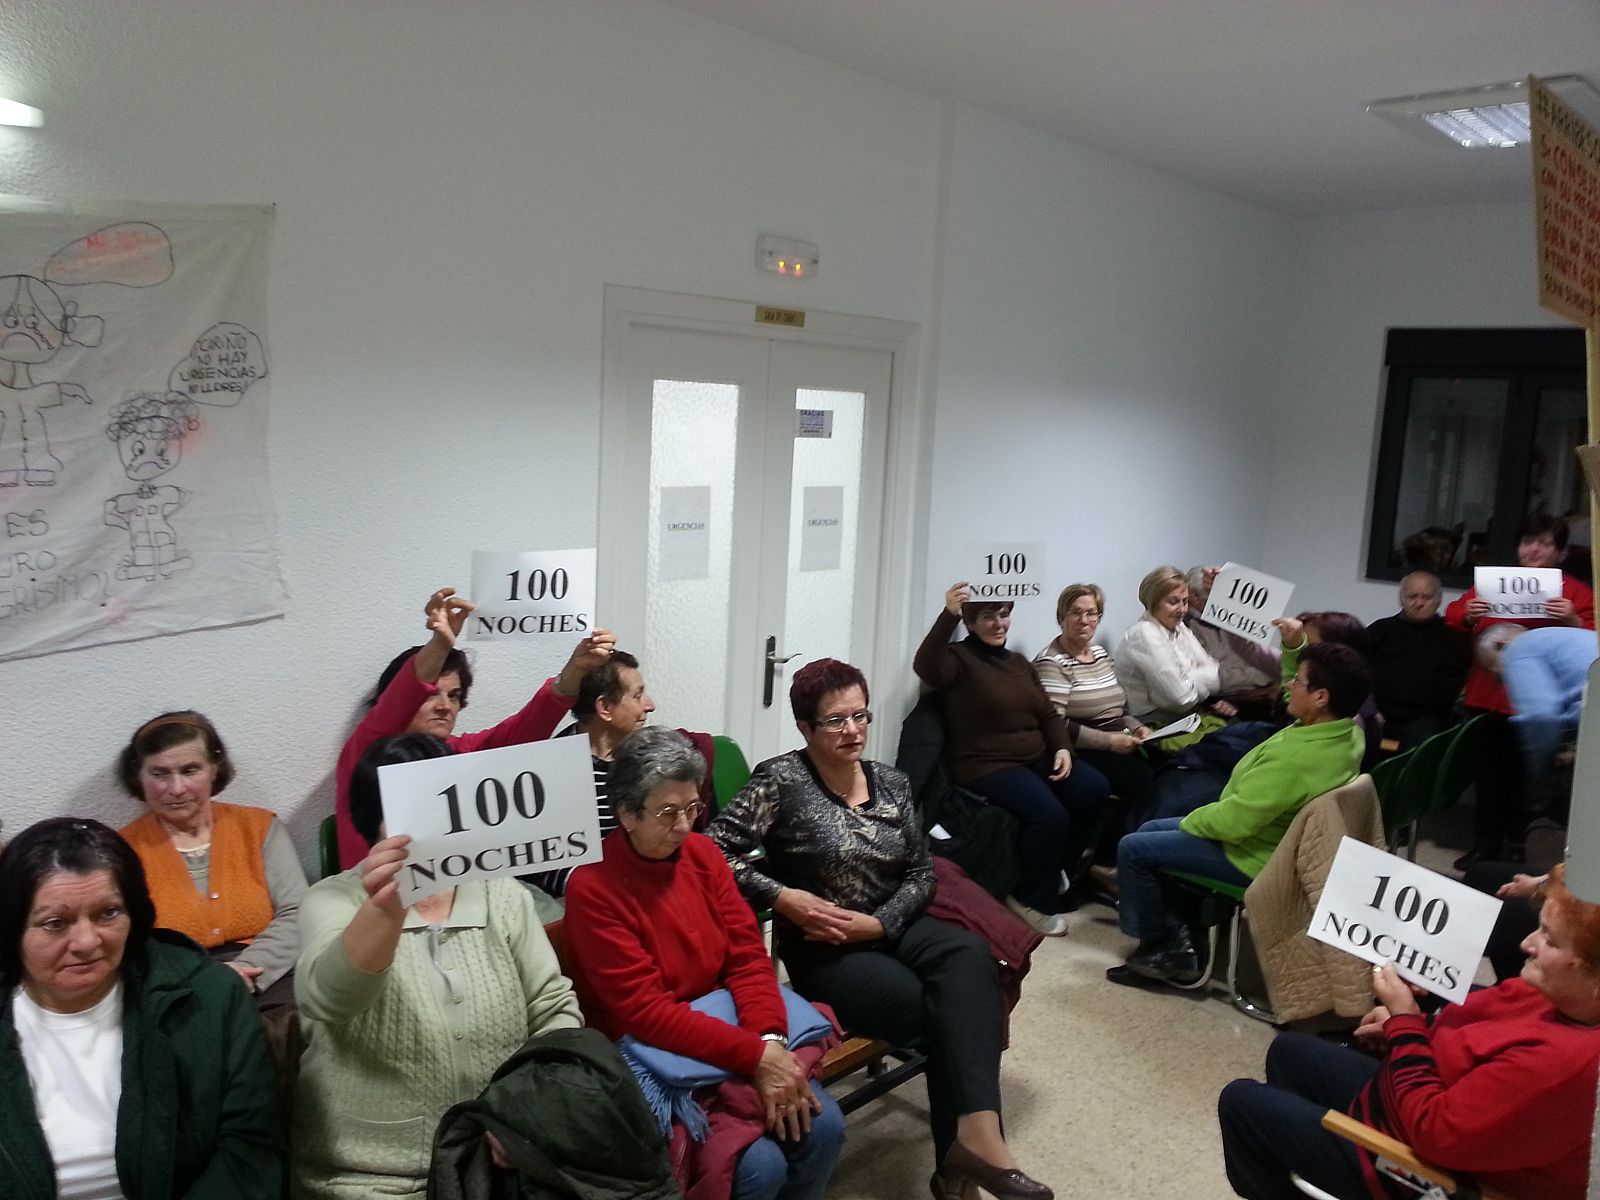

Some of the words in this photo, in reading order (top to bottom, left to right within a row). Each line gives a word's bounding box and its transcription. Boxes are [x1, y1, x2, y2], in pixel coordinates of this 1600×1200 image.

[218, 351, 248, 366] HAY
[984, 552, 1026, 575] 100
[505, 568, 569, 601] 100
[970, 583, 1041, 597] NOCHES
[1228, 578, 1269, 610] 100
[1498, 576, 1539, 595] 100
[475, 613, 588, 635] NOCHES
[1206, 603, 1271, 639] NOCHES
[1486, 602, 1547, 615] OCHE
[437, 771, 546, 836] 100
[406, 831, 589, 892] NOCHES
[1366, 874, 1450, 936] 100
[1322, 911, 1461, 990] NOCHES
